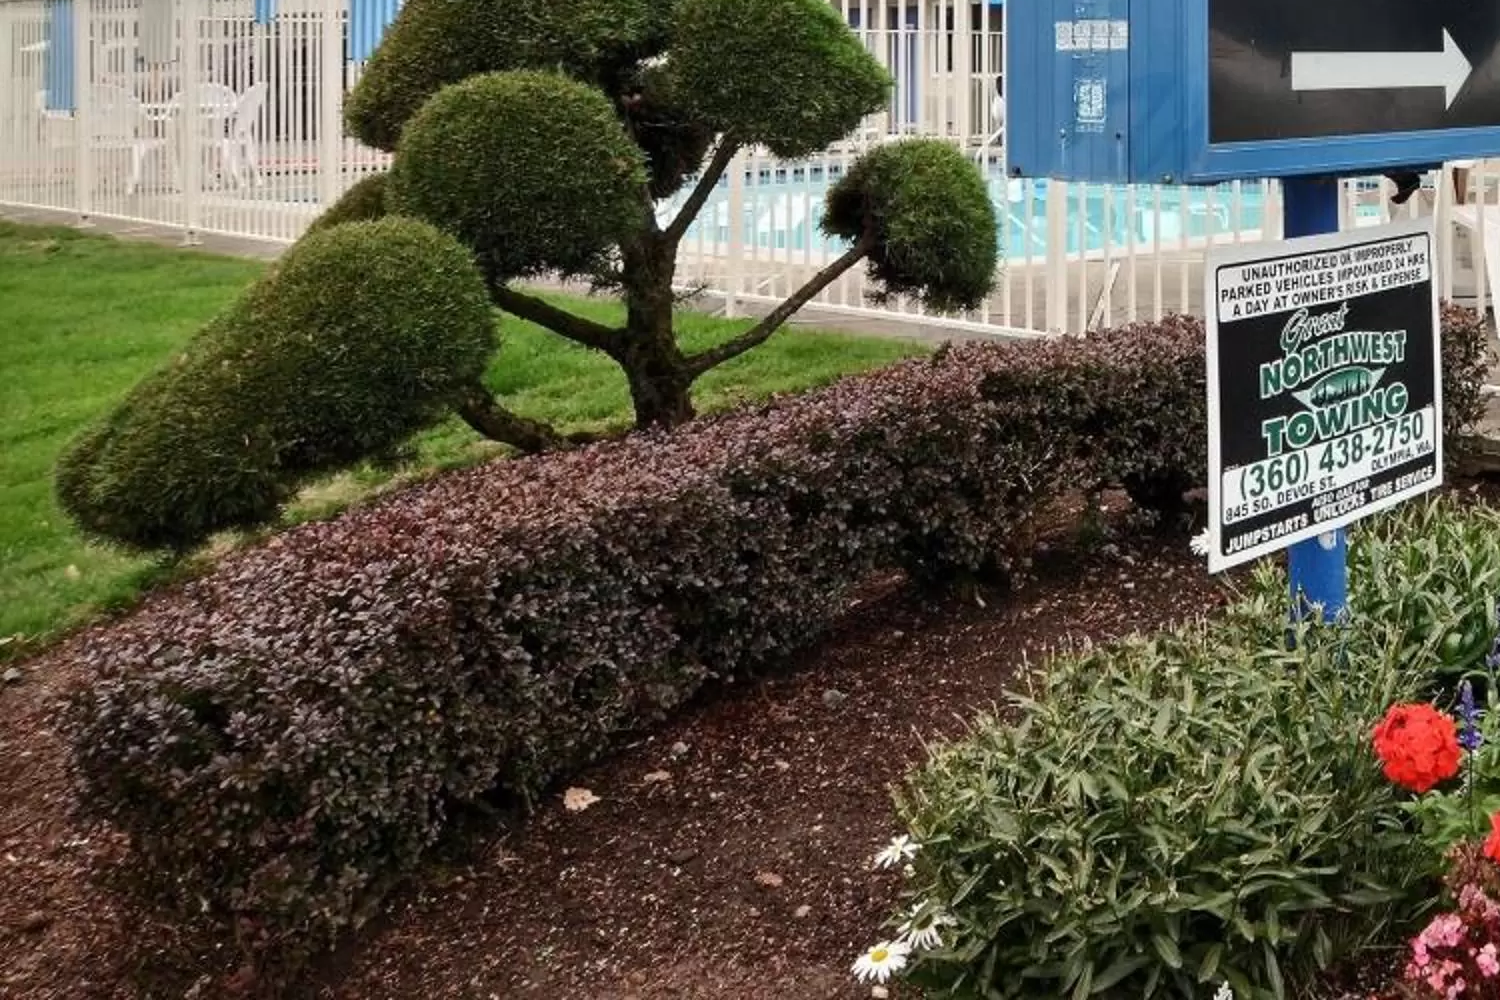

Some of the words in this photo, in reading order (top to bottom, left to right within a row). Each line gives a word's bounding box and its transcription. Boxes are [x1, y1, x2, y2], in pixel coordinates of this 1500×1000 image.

[1221, 282, 1271, 303] PARKED
[1275, 271, 1334, 293] VEHICLES
[1337, 259, 1392, 283] IMPOUNDED
[1407, 253, 1425, 268] HRS
[1241, 254, 1338, 283] UNAUTHORIZED
[1340, 252, 1352, 266] OR
[1354, 240, 1412, 262] IMPROPERLY
[1233, 303, 1241, 316] A
[1245, 298, 1269, 315] DAY
[1273, 295, 1288, 311] AT
[1291, 285, 1344, 306] OWNER'S
[1345, 279, 1369, 295] RISK
[1371, 277, 1379, 290] &
[1381, 267, 1421, 288] EXPENSE
[1279, 301, 1350, 356] Great
[1259, 329, 1406, 399] NORTHWEST
[1261, 381, 1409, 457] TOWING
[1239, 449, 1309, 501] (360)
[1319, 411, 1424, 473] 438-2750
[1225, 513, 1309, 554] JUMPSTARTS
[1370, 481, 1394, 501] TIRE
[1395, 465, 1434, 492] SERVICE
[1253, 496, 1273, 514] SO.
[1277, 481, 1316, 505] DEVOE
[1319, 475, 1337, 491] ST.
